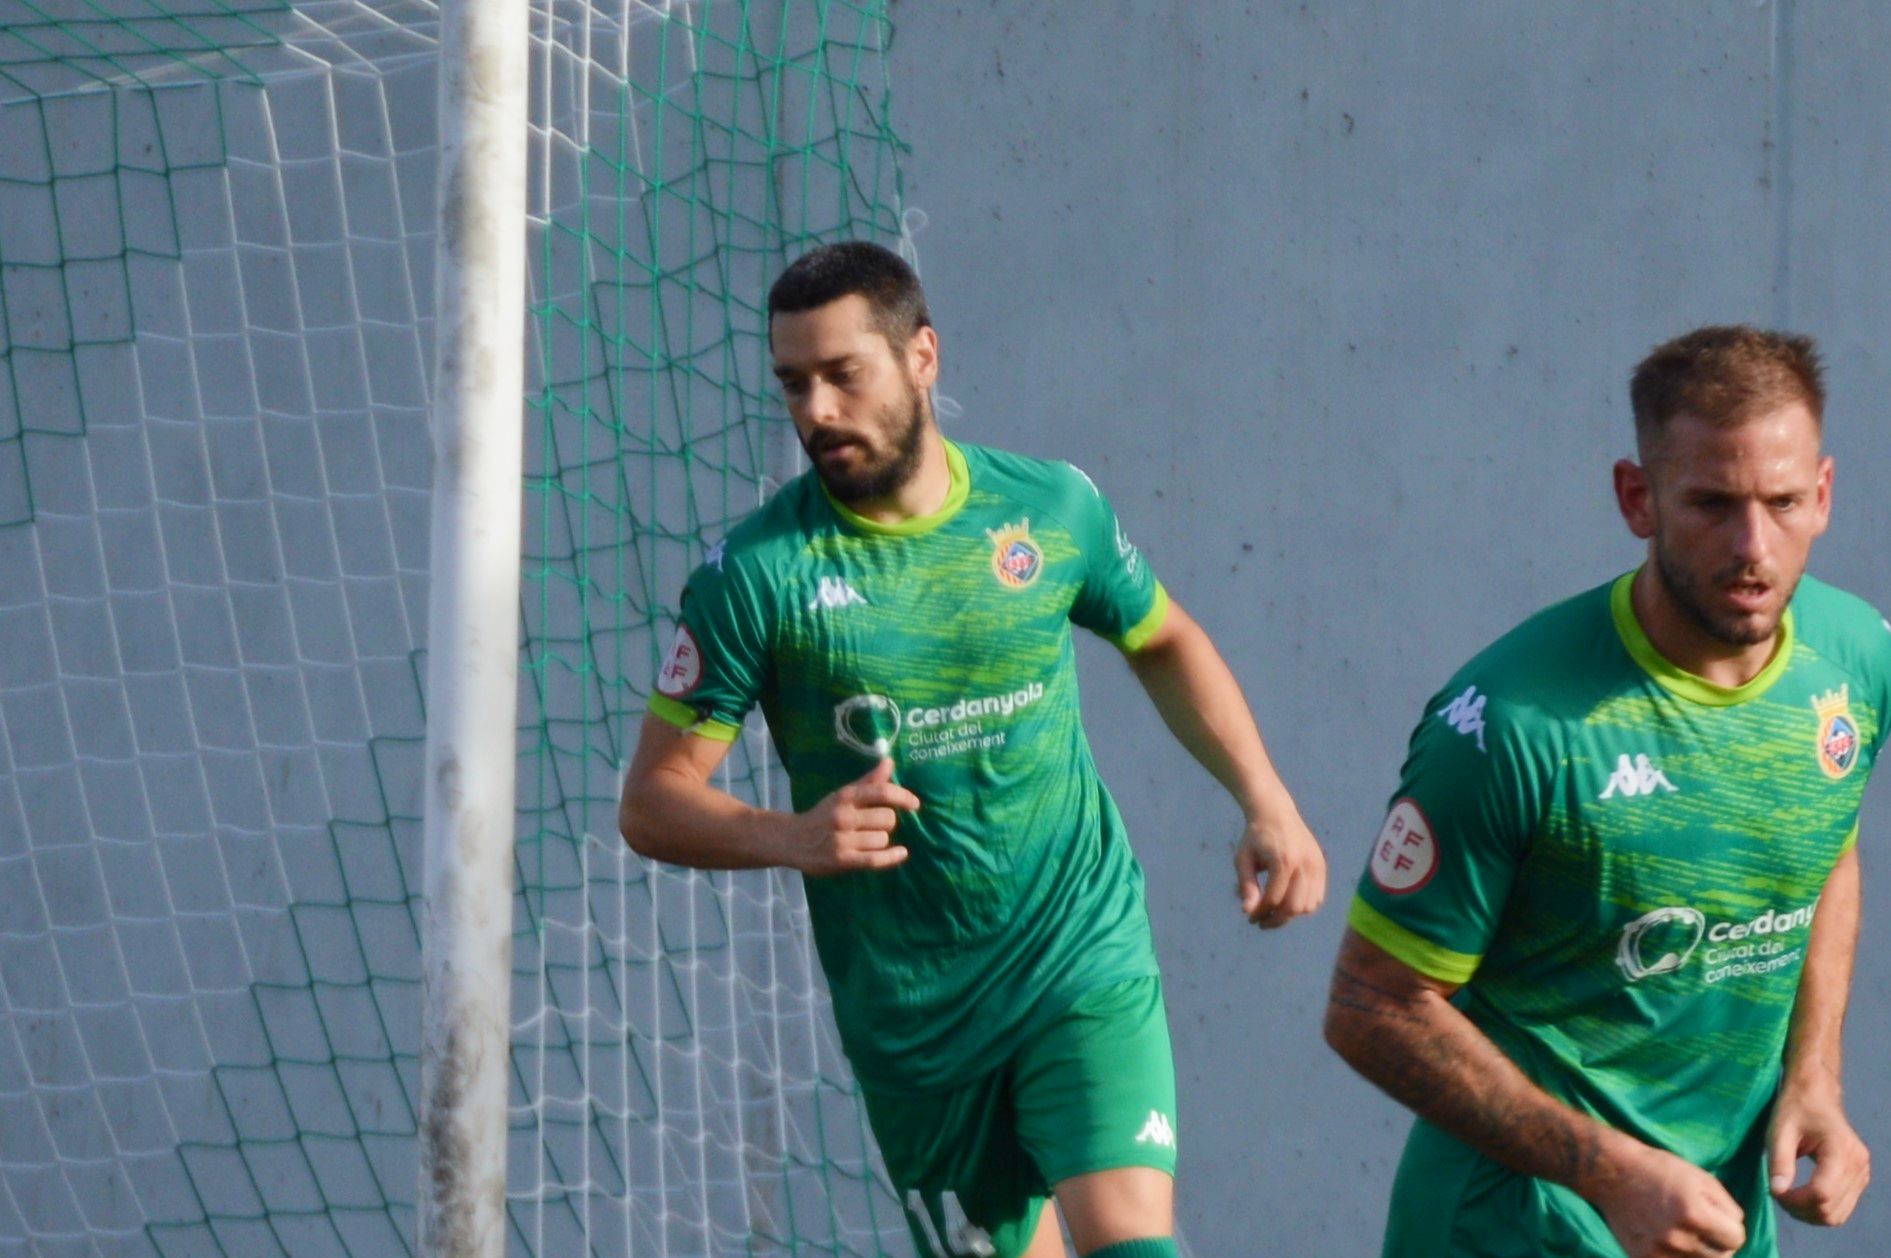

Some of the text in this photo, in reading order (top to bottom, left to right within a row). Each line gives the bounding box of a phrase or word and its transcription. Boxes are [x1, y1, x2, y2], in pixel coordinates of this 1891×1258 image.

[907, 682, 1043, 728] Cerdanyola
[908, 719, 983, 747] Ciutat del
[908, 731, 1006, 761] coneixement
